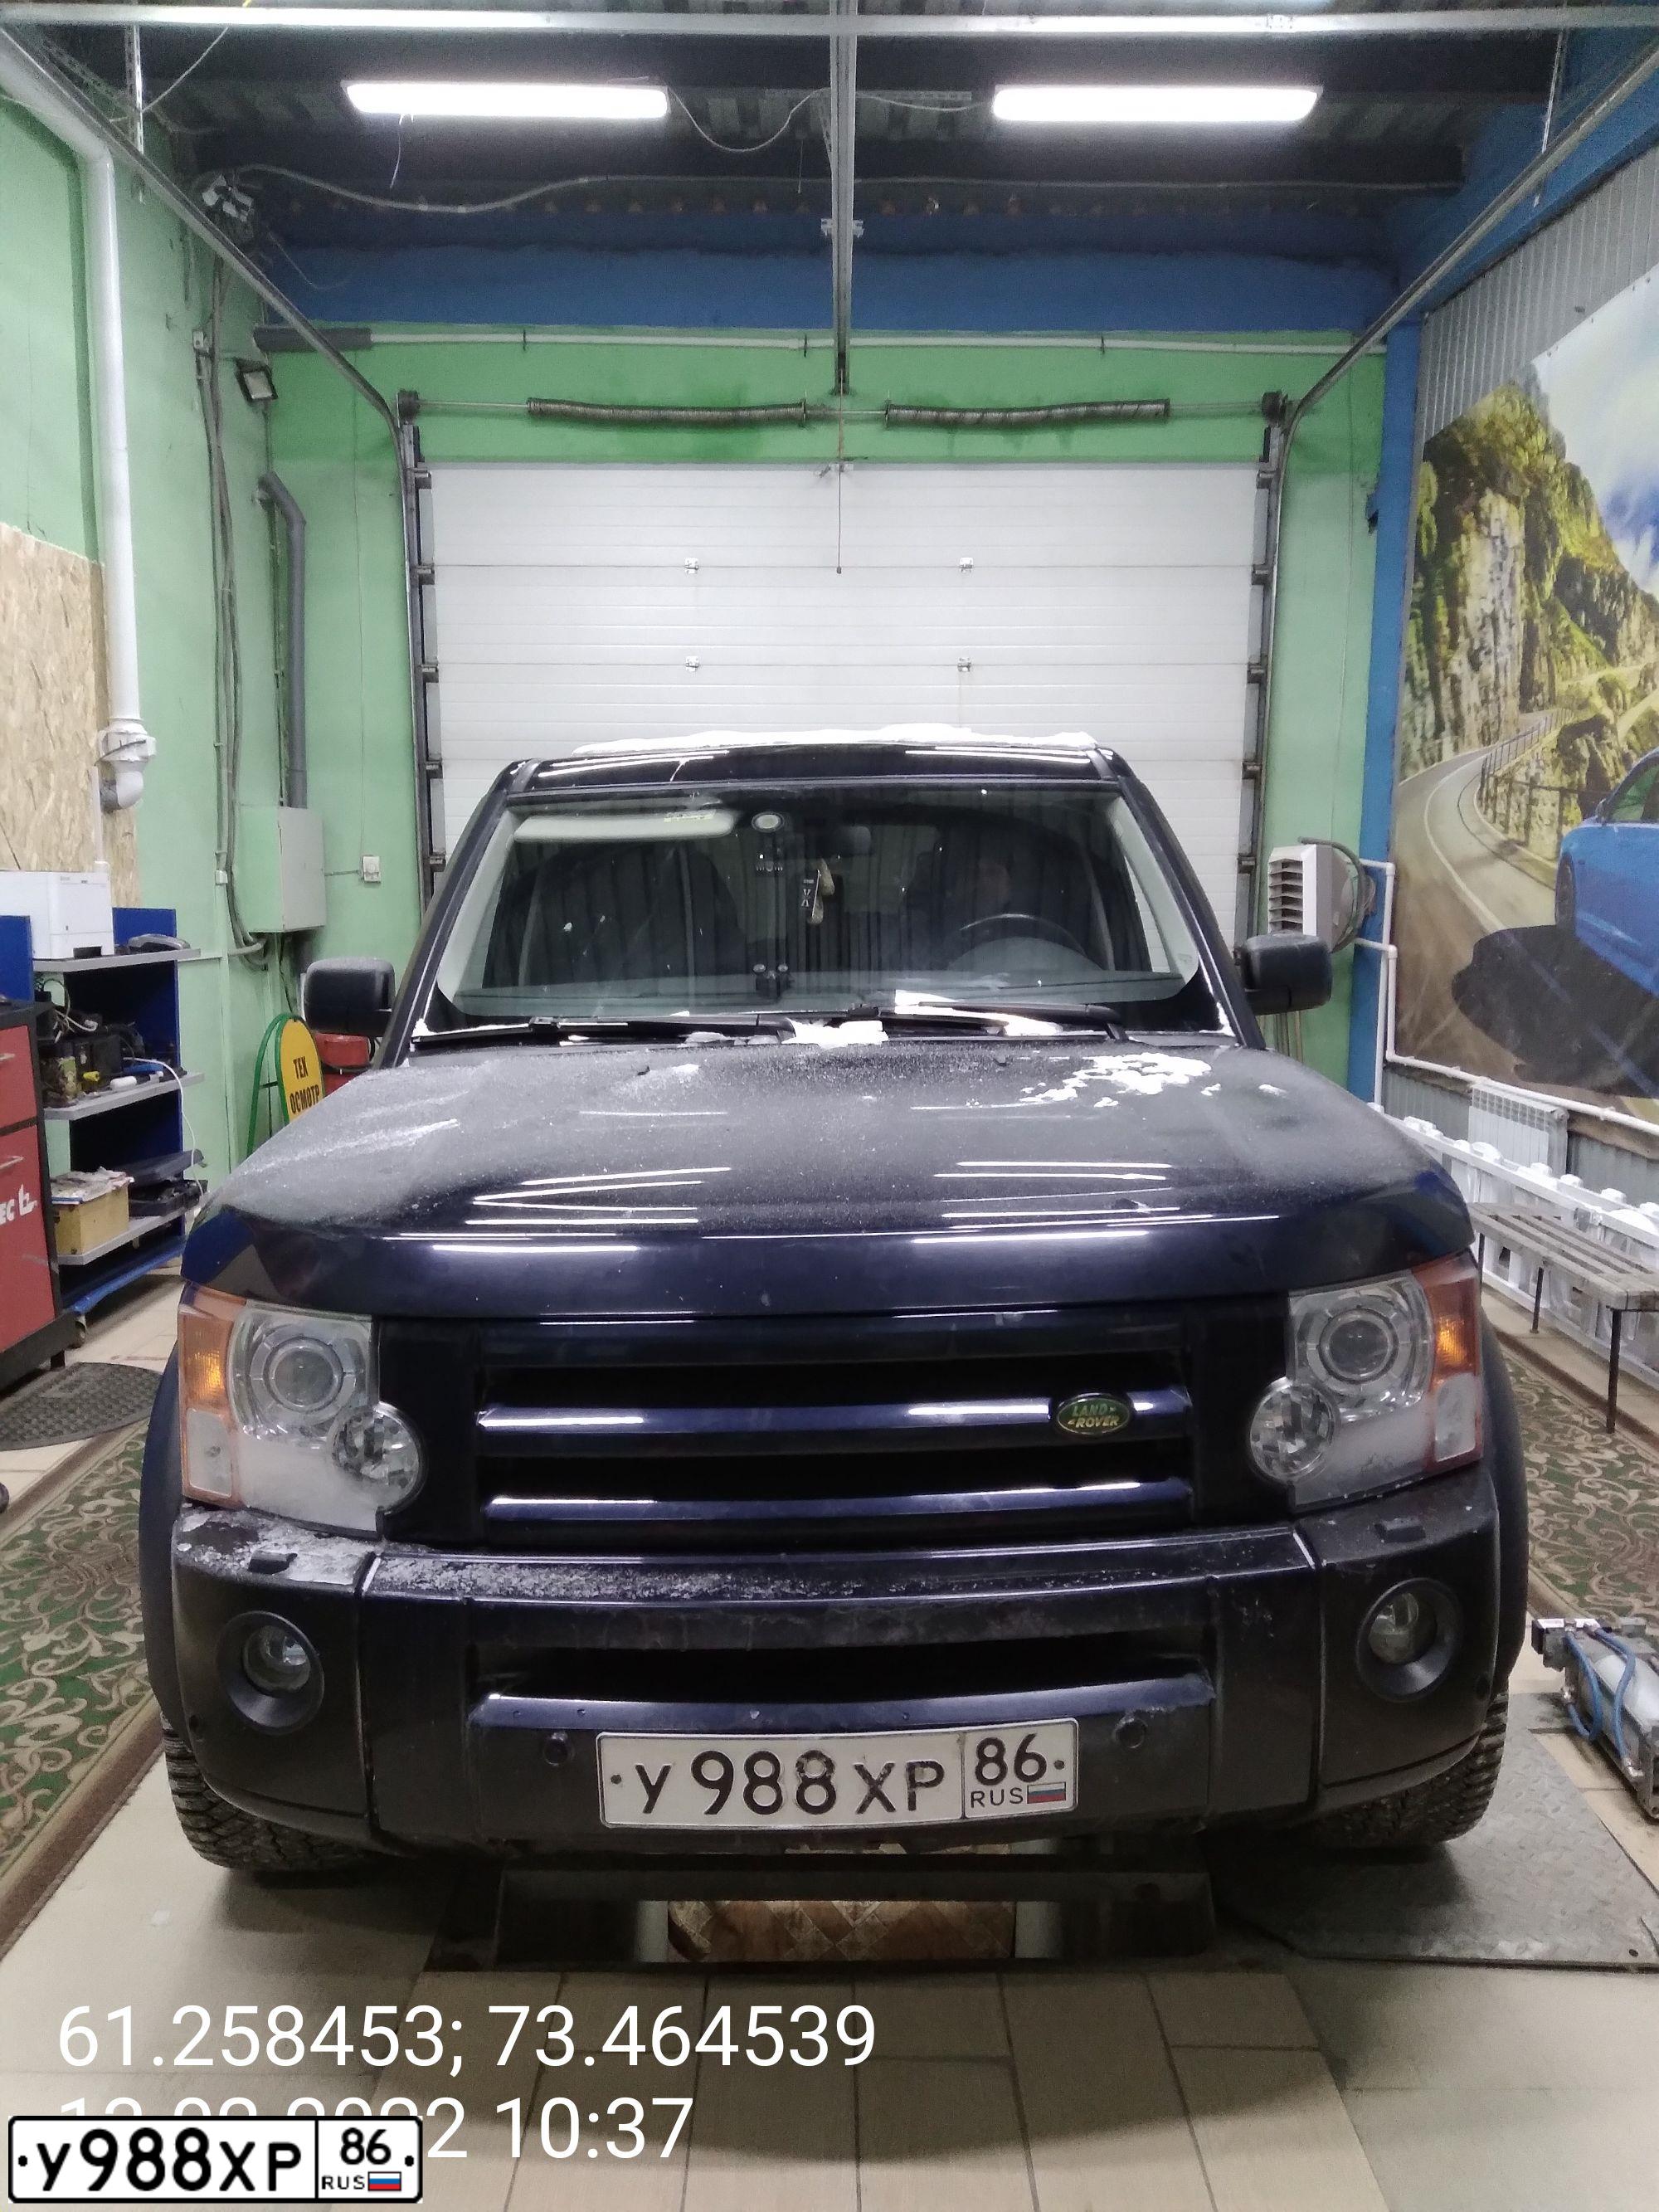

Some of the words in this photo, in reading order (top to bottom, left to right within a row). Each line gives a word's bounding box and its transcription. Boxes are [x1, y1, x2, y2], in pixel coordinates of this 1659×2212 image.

[293, 1056, 309, 1079] ТЕХ
[290, 1084, 320, 1113] ОСМОТР
[1073, 1403, 1108, 1416] LAND
[1076, 1415, 1120, 1428] ROVER
[974, 1733, 1048, 1786] 86
[970, 1786, 1024, 1809] RUS
